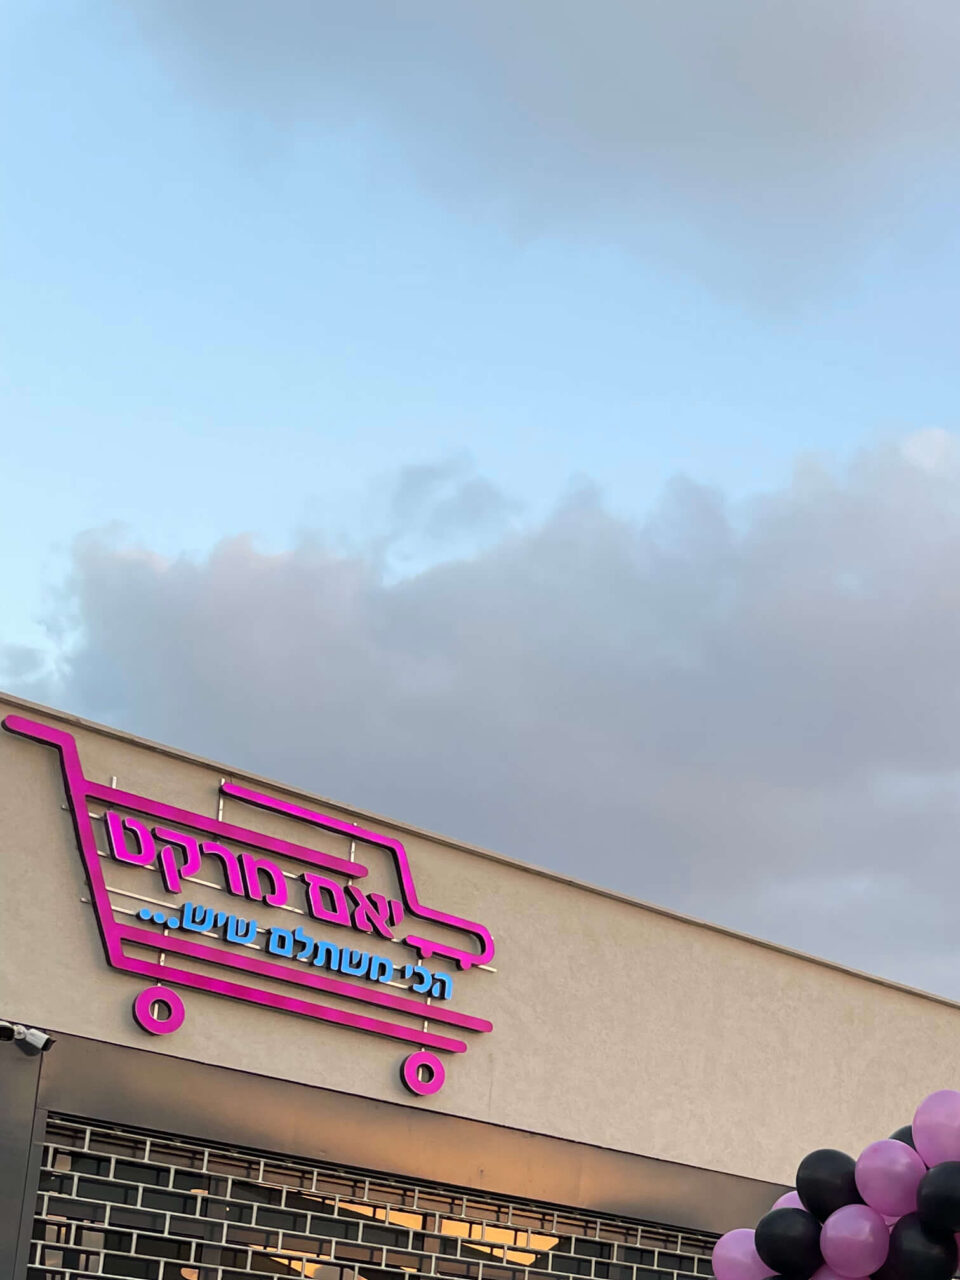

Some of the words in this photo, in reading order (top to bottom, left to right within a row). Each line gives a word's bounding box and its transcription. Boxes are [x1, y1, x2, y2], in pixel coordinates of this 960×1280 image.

[105, 810, 288, 907] מרקט
[137, 902, 258, 944] שיש...
[302, 871, 404, 939] יאם
[267, 926, 394, 983] משתלם
[403, 964, 453, 1000] הכי
